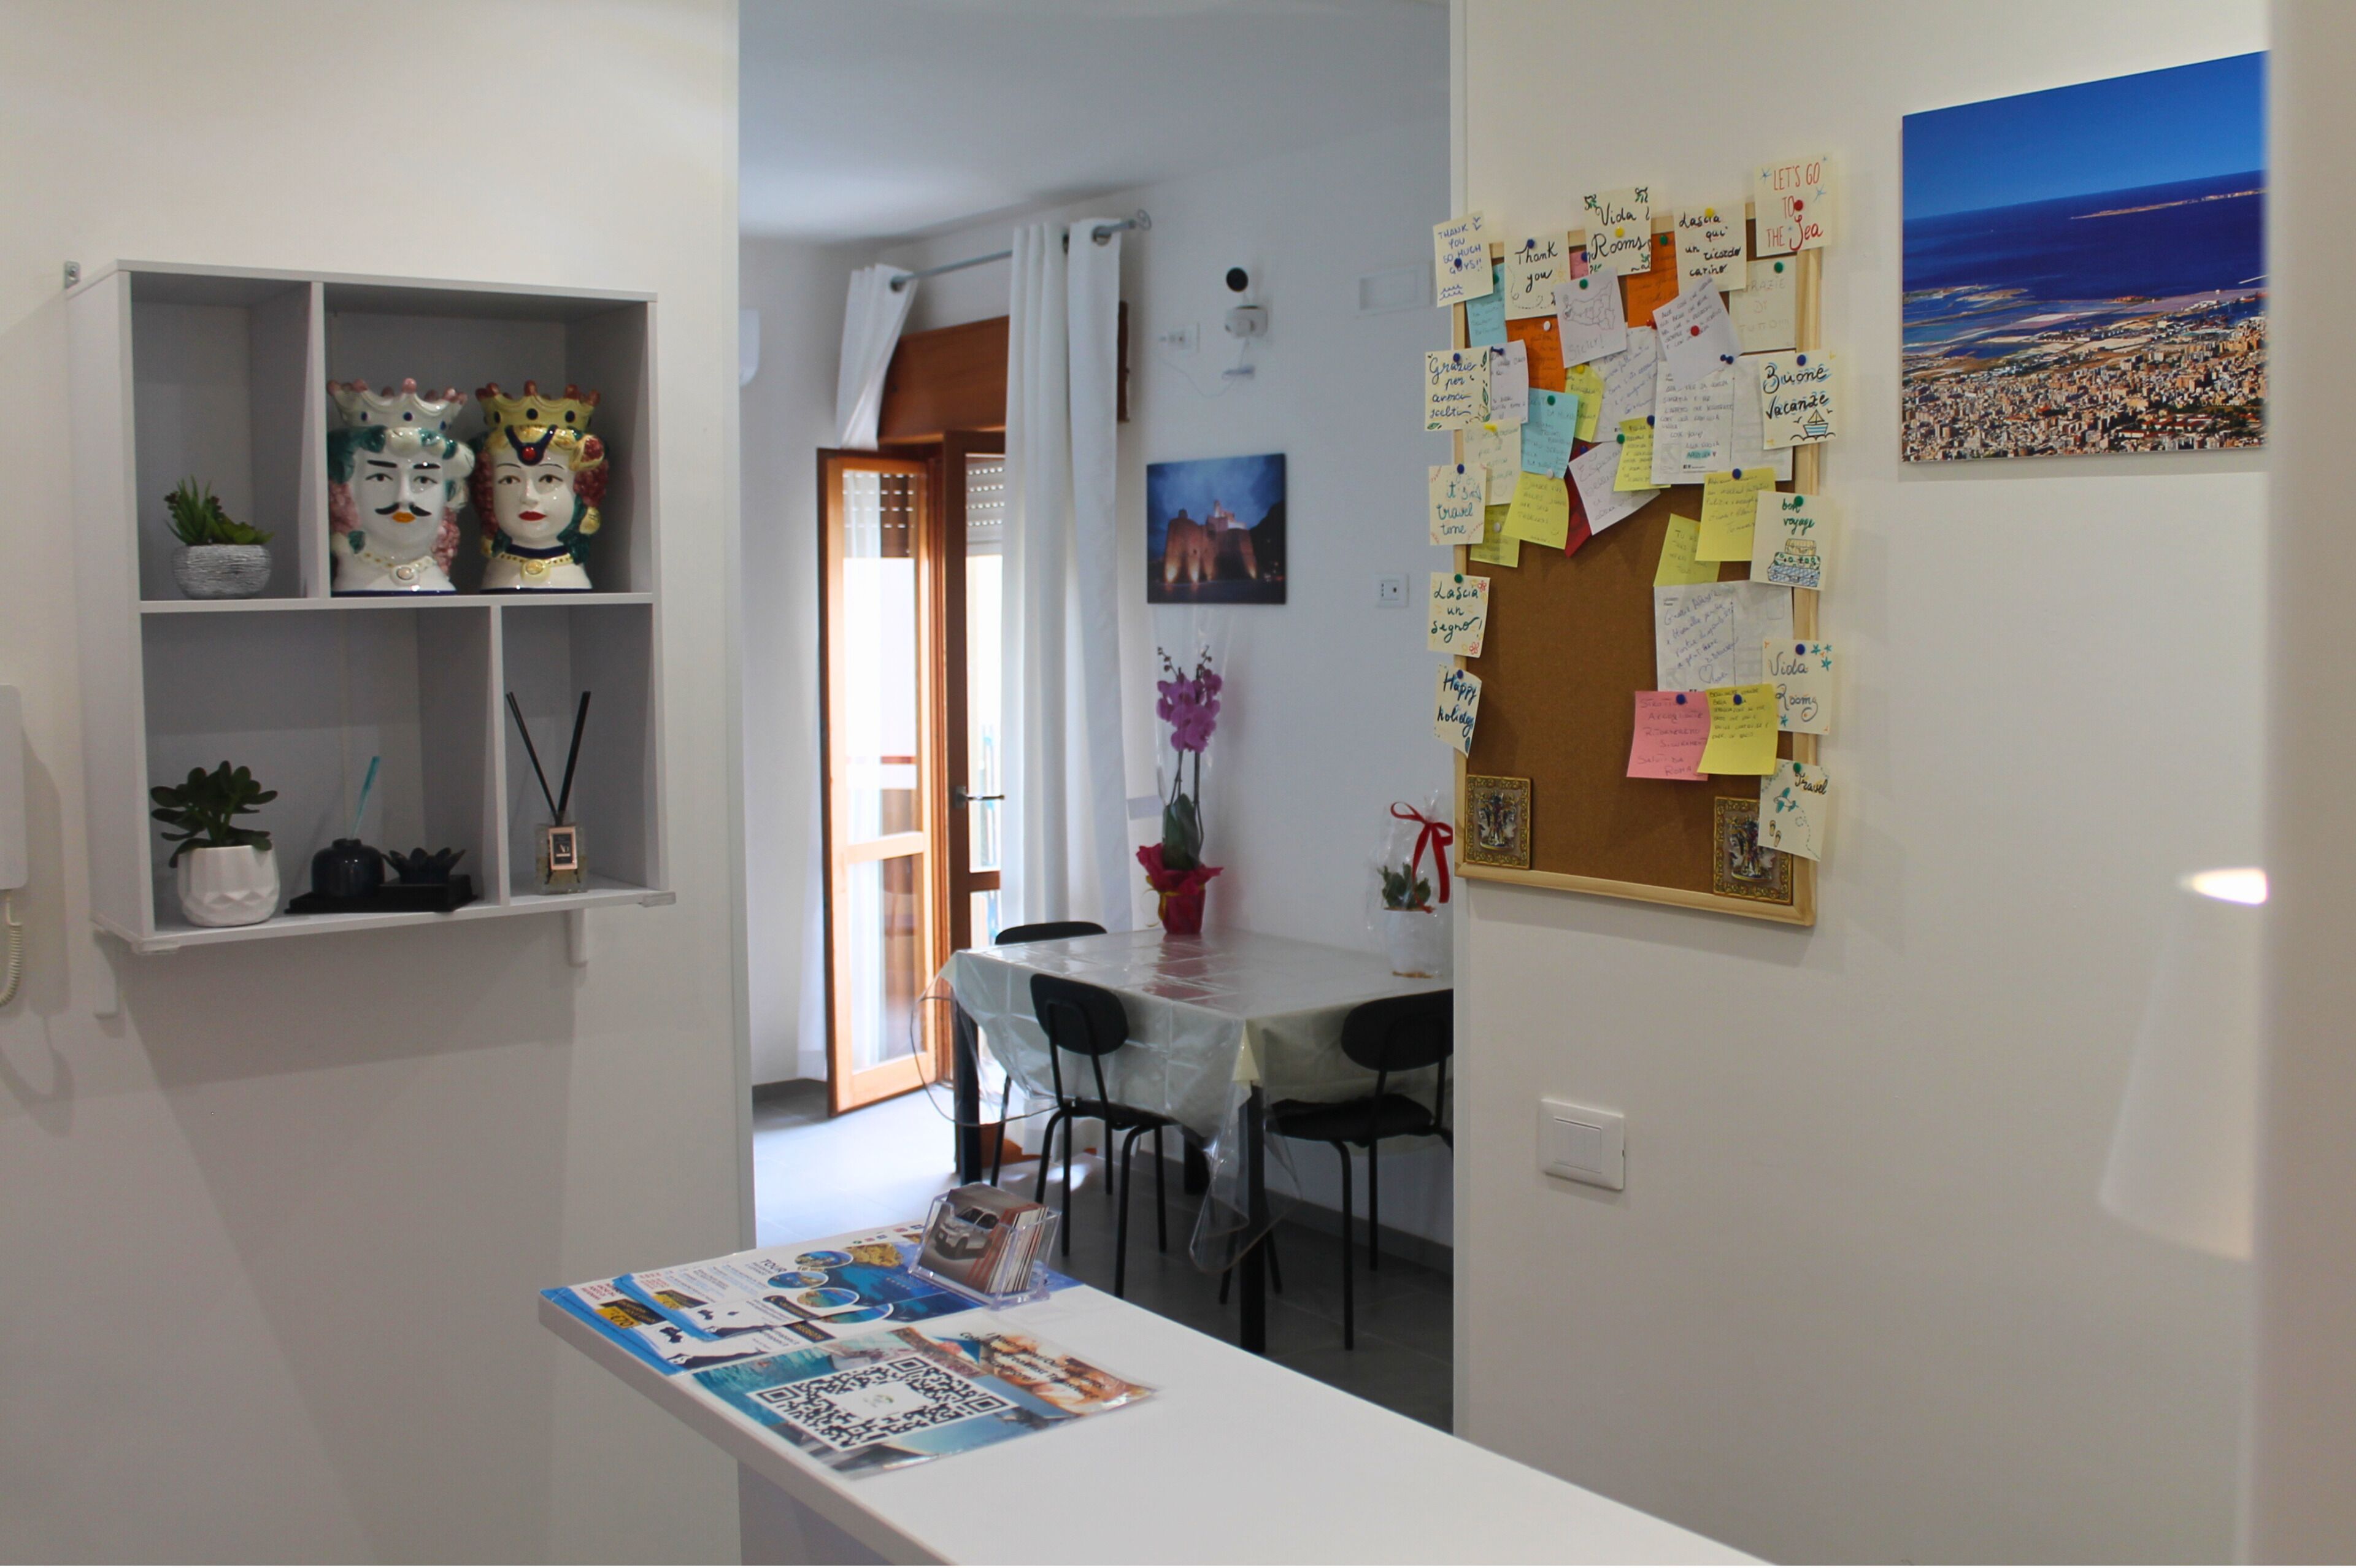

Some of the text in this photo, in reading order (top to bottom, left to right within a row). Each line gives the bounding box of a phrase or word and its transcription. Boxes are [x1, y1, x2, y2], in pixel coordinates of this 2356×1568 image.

[1774, 162, 1820, 190] LET'S GO
[1595, 202, 1637, 226] Vida
[1782, 195, 1795, 219] TO
[1438, 224, 1468, 239] THANK
[1449, 238, 1465, 249] YOU
[1766, 215, 1823, 251] THE Sea
[1444, 244, 1481, 264] SO MUCH
[1515, 241, 1558, 265] Thank
[1587, 233, 1646, 262] Rooms
[1526, 269, 1553, 293] you
[1429, 357, 1477, 385] Grazie
[1763, 364, 1827, 394] Buone
[1445, 378, 1465, 391] per
[1765, 394, 1830, 420] Vacanze
[1434, 580, 1479, 599] Lascia
[1447, 606, 1464, 616] un
[1769, 651, 1808, 676] Vida
[1443, 671, 1477, 705] Happy
[1795, 772, 1828, 794] Travel
